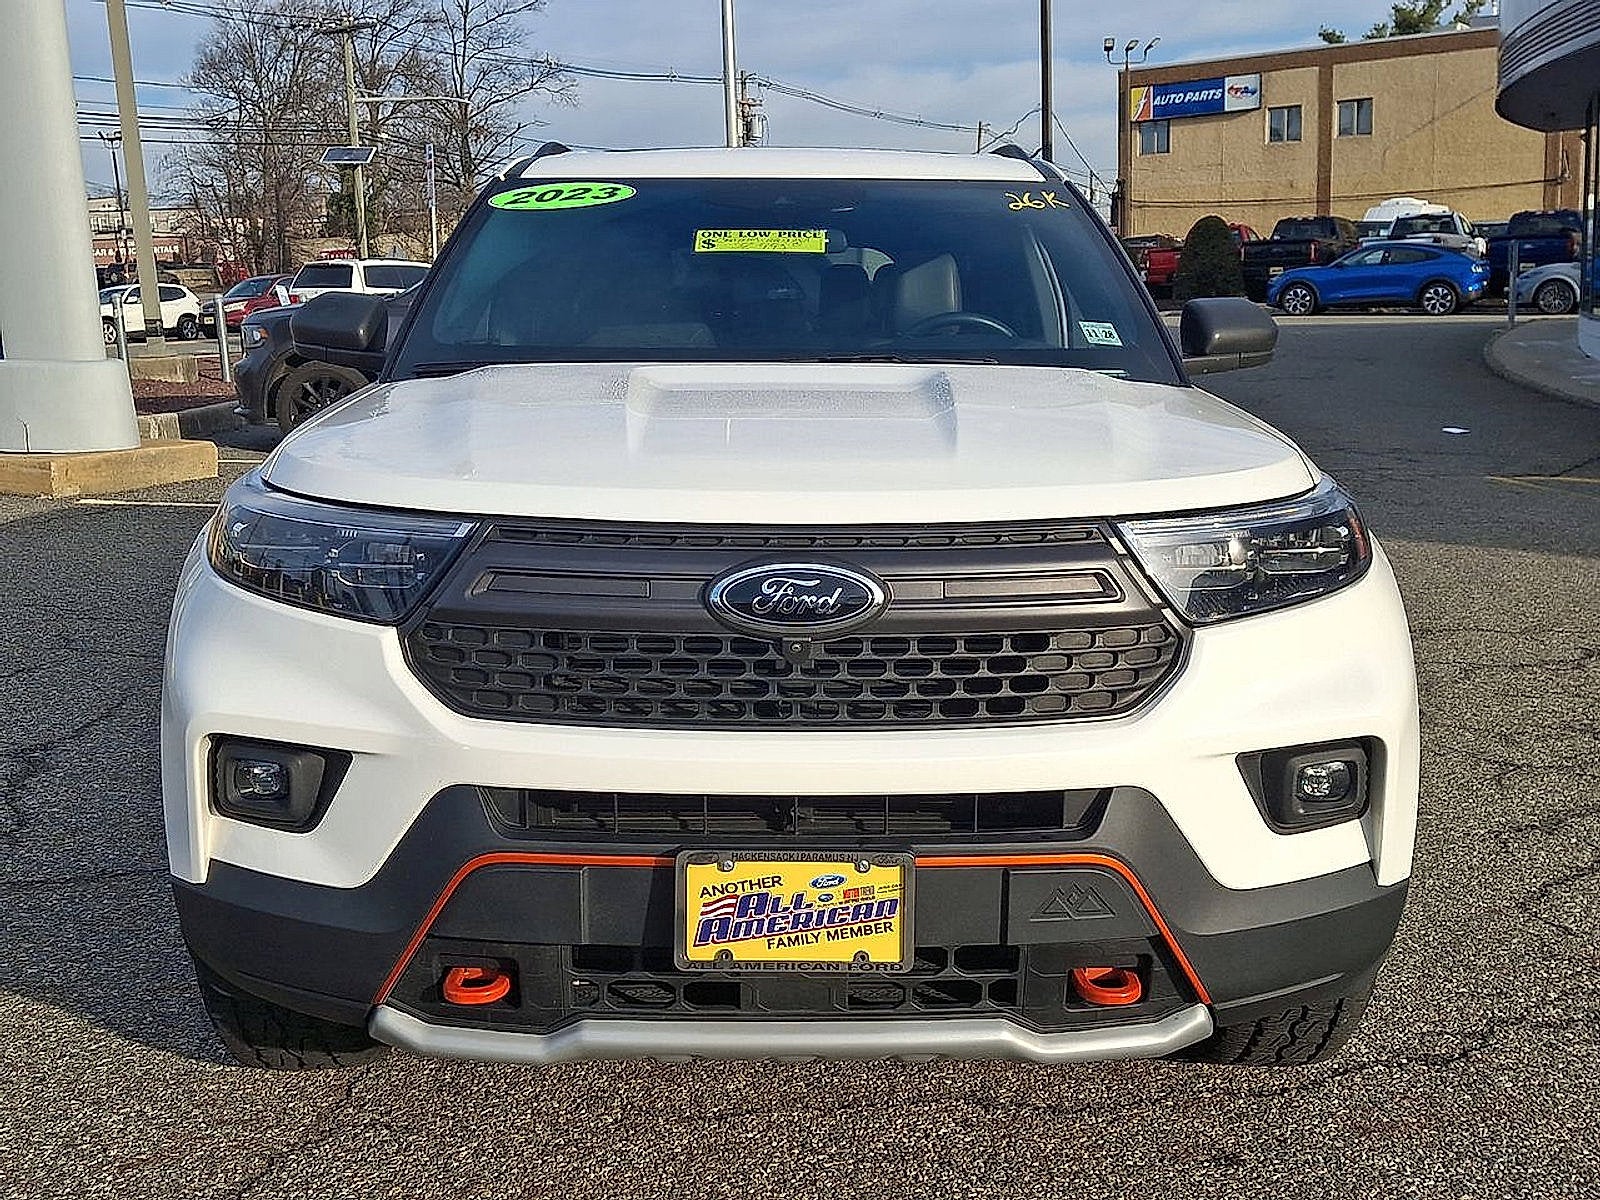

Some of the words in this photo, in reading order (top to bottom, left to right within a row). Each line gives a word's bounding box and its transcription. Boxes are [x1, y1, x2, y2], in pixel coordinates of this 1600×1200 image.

[1153, 93, 1184, 106] AUTO
[1184, 88, 1223, 103] PARTS
[502, 186, 622, 207] 2023
[1005, 190, 1071, 210] 26K
[701, 231, 731, 239] ONE
[738, 231, 771, 239] LOW
[778, 231, 824, 239] PRICE
[751, 576, 844, 614] Ford
[699, 875, 784, 899] ANOTHER
[735, 891, 815, 919] ALL
[766, 931, 822, 950] FAMILY
[826, 921, 895, 942] MEMBER
[688, 962, 722, 970] ALL
[732, 962, 840, 971] AMERICAN
[847, 962, 904, 971] FORD
